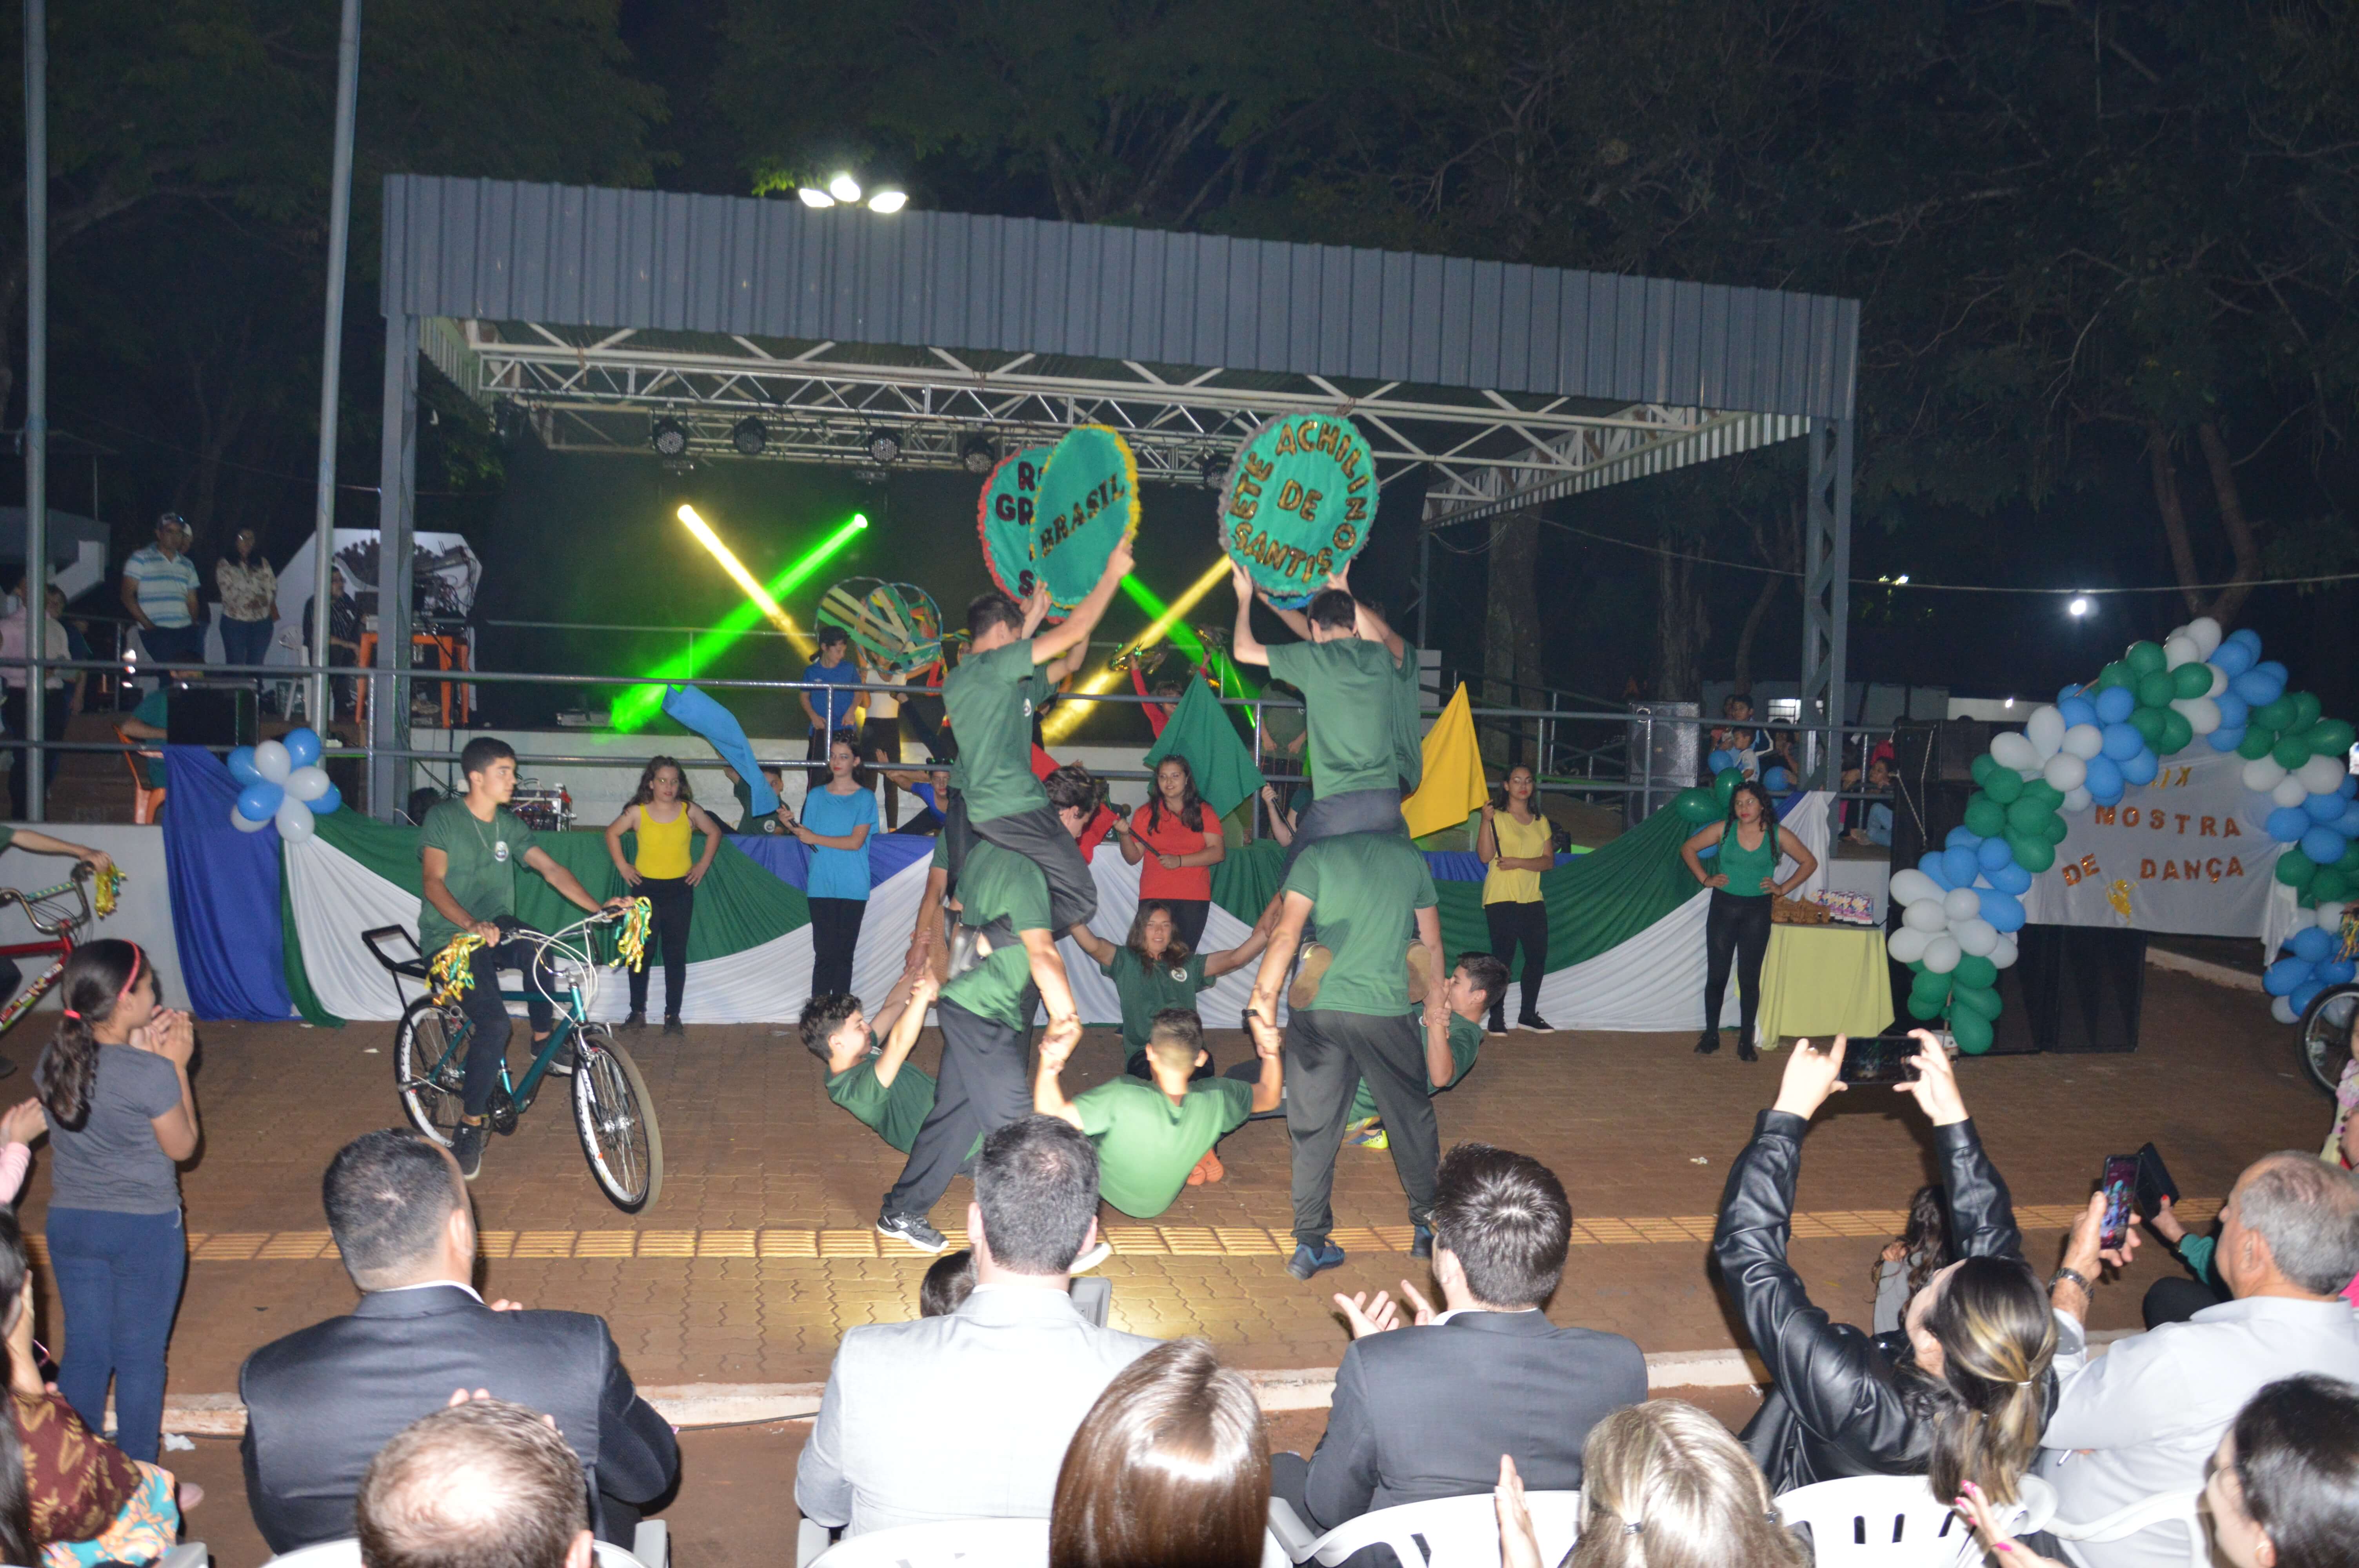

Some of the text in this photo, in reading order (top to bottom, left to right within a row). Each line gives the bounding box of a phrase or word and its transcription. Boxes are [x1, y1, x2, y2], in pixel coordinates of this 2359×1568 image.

[1276, 420, 1370, 550] ACHILINO
[1278, 479, 1323, 521] DE
[1040, 473, 1125, 558] BRASIL
[1232, 522, 1333, 583] SANTIS
[2095, 805, 2242, 837] MOSTRA
[2062, 853, 2244, 887] DE DANÇA
